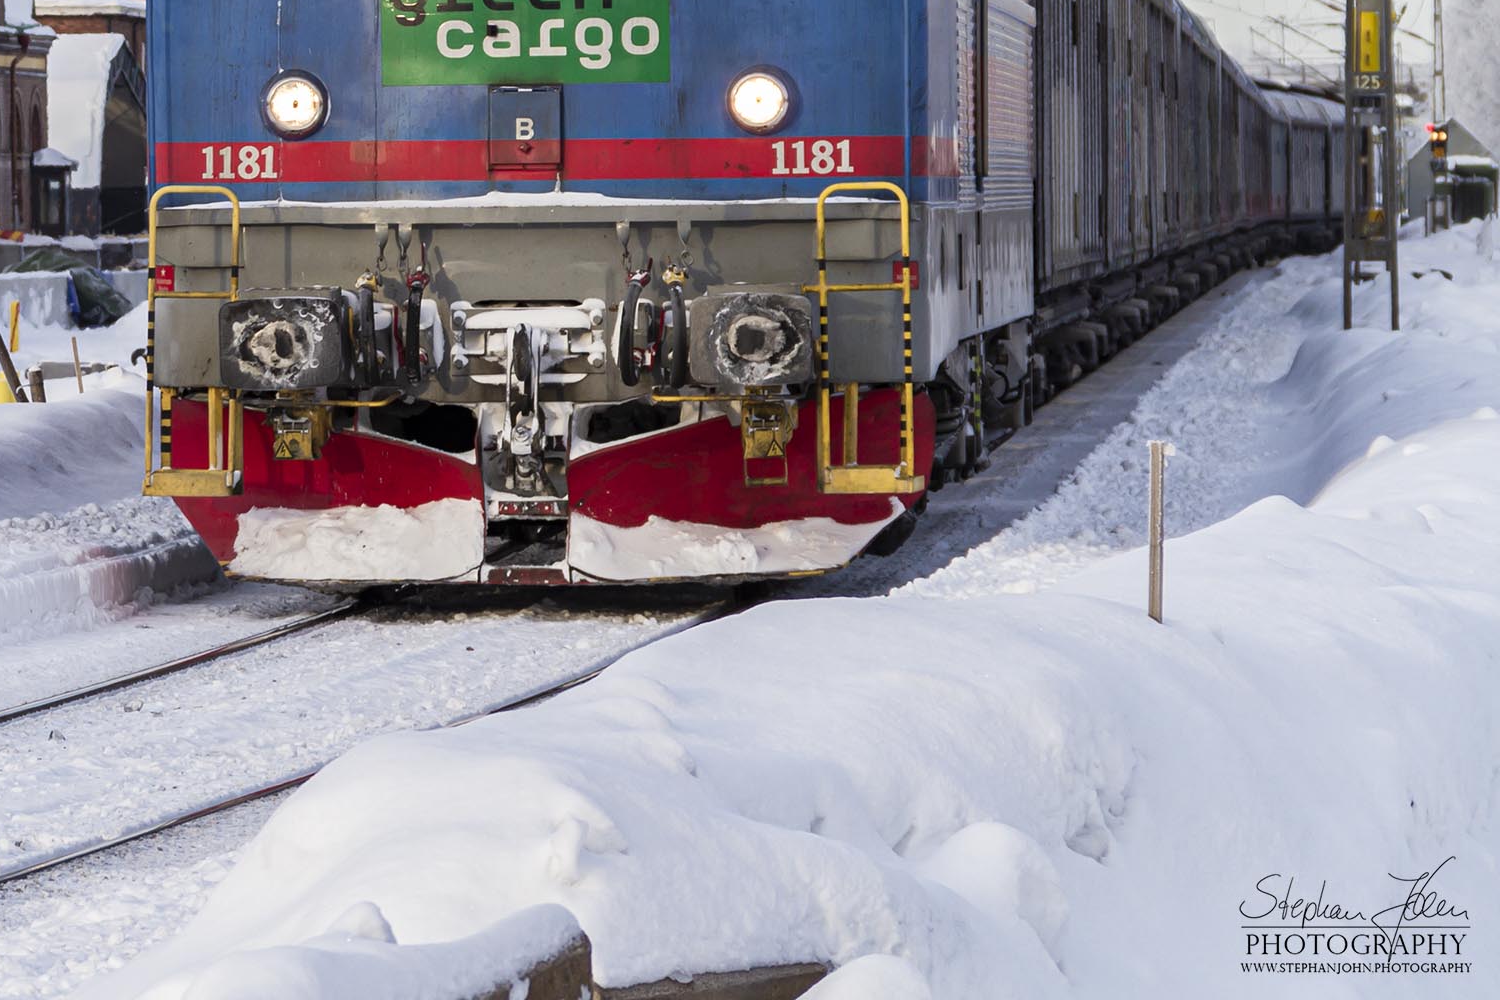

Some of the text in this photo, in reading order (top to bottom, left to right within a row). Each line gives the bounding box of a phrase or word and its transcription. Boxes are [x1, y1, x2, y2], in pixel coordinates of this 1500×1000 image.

[436, 16, 660, 70] cargo
[1354, 74, 1381, 90] 125
[515, 117, 535, 140] B
[202, 145, 278, 180] 1181
[771, 139, 854, 175] 1181
